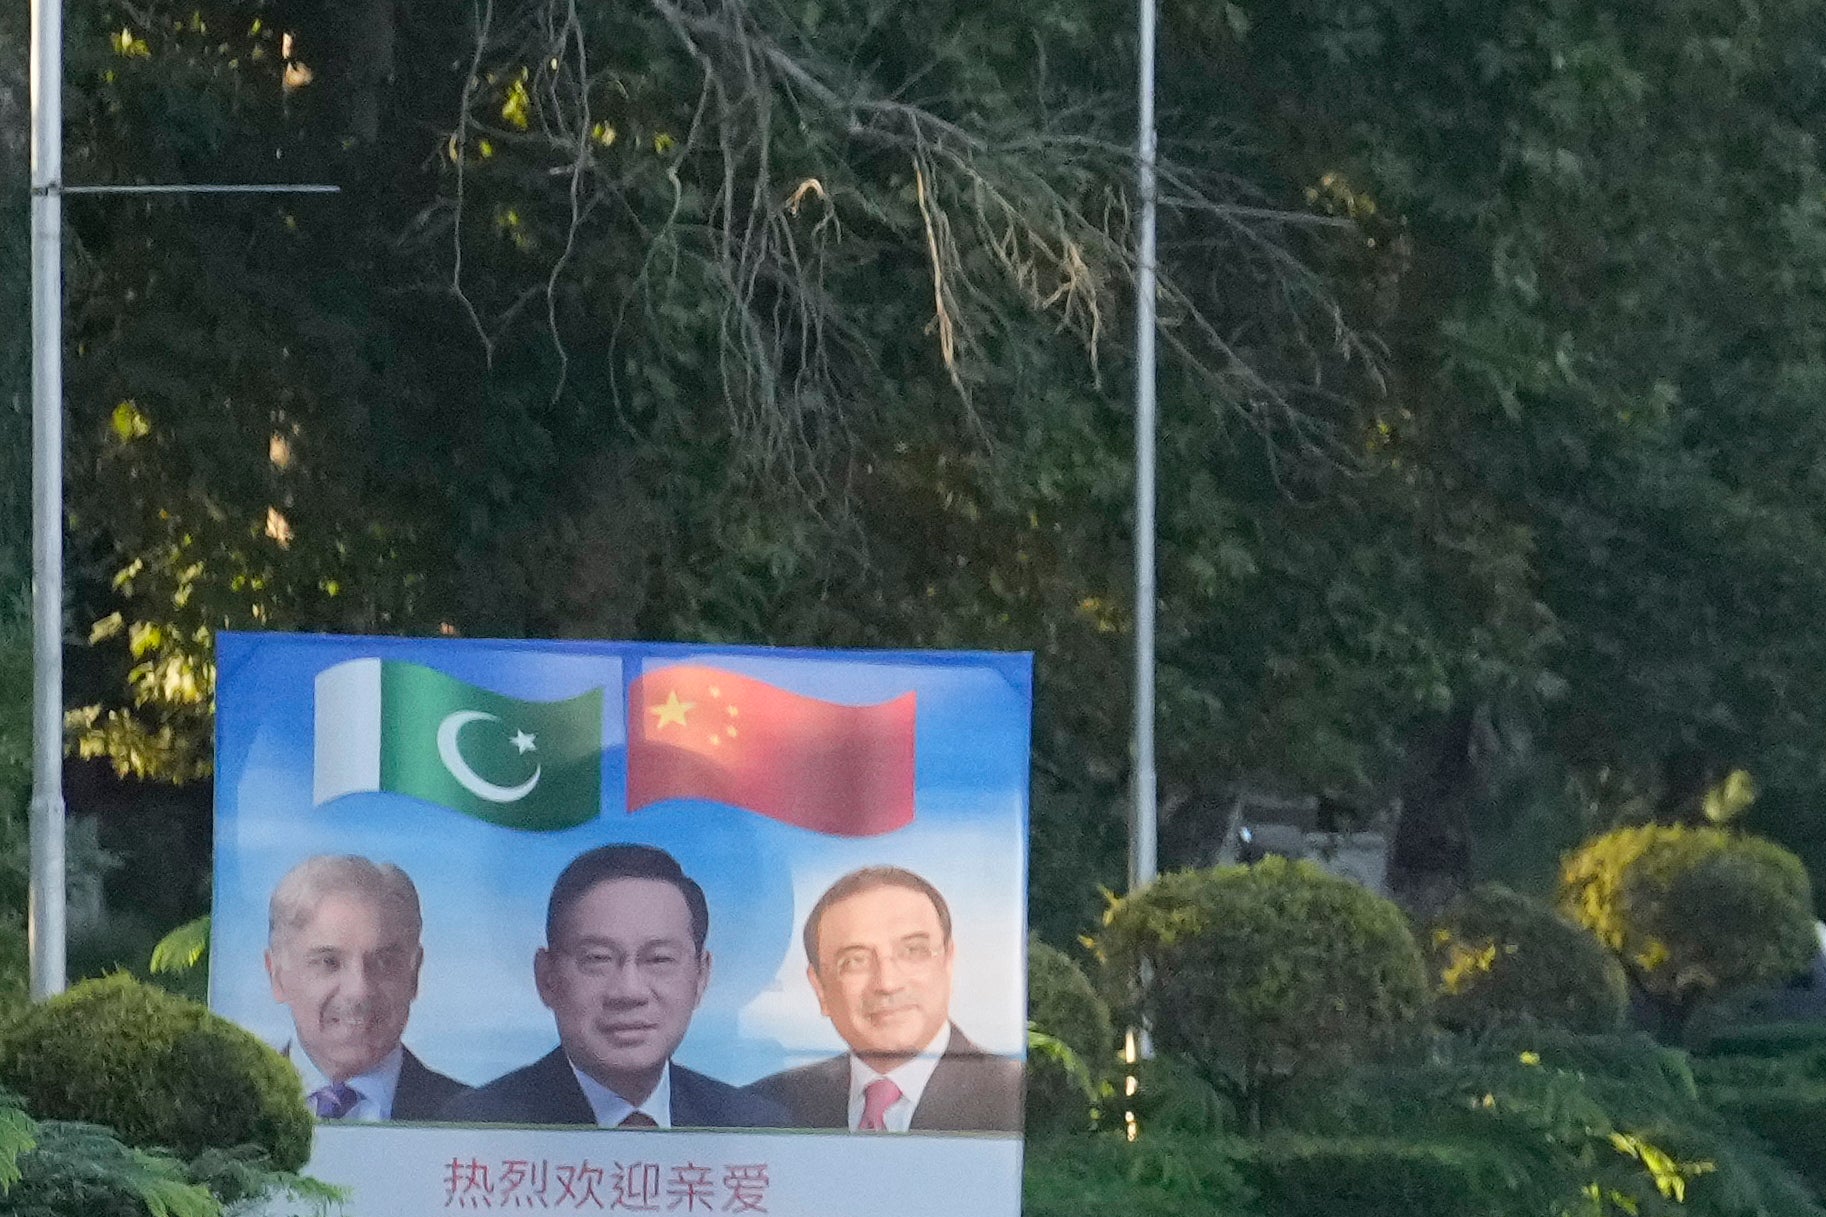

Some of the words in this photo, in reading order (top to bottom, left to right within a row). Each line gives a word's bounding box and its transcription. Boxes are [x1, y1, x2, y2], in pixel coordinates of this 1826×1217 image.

[444, 1157, 770, 1213] 热烈欢迎亲爱
